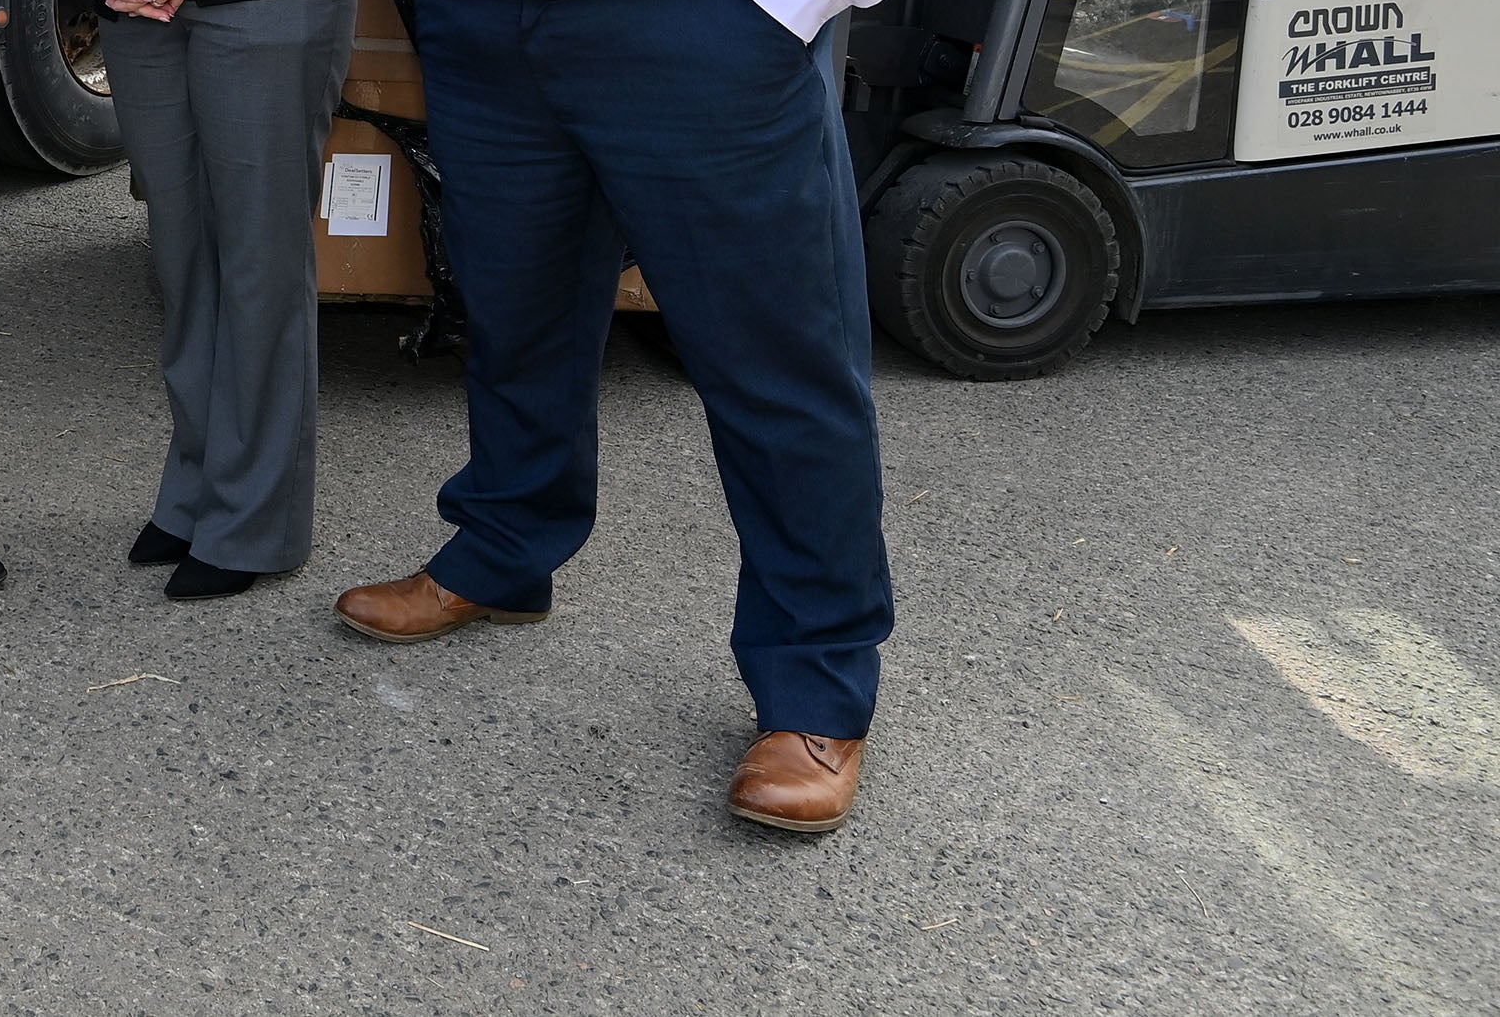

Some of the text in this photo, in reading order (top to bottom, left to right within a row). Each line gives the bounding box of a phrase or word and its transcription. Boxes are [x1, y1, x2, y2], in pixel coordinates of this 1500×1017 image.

[1288, 2, 1404, 39] CROWN
[1290, 71, 1428, 94] THE FORKLIFT CENTRE
[1287, 98, 1428, 129] 028 9084 1444
[1313, 123, 1402, 141] www.whall.co.uk
